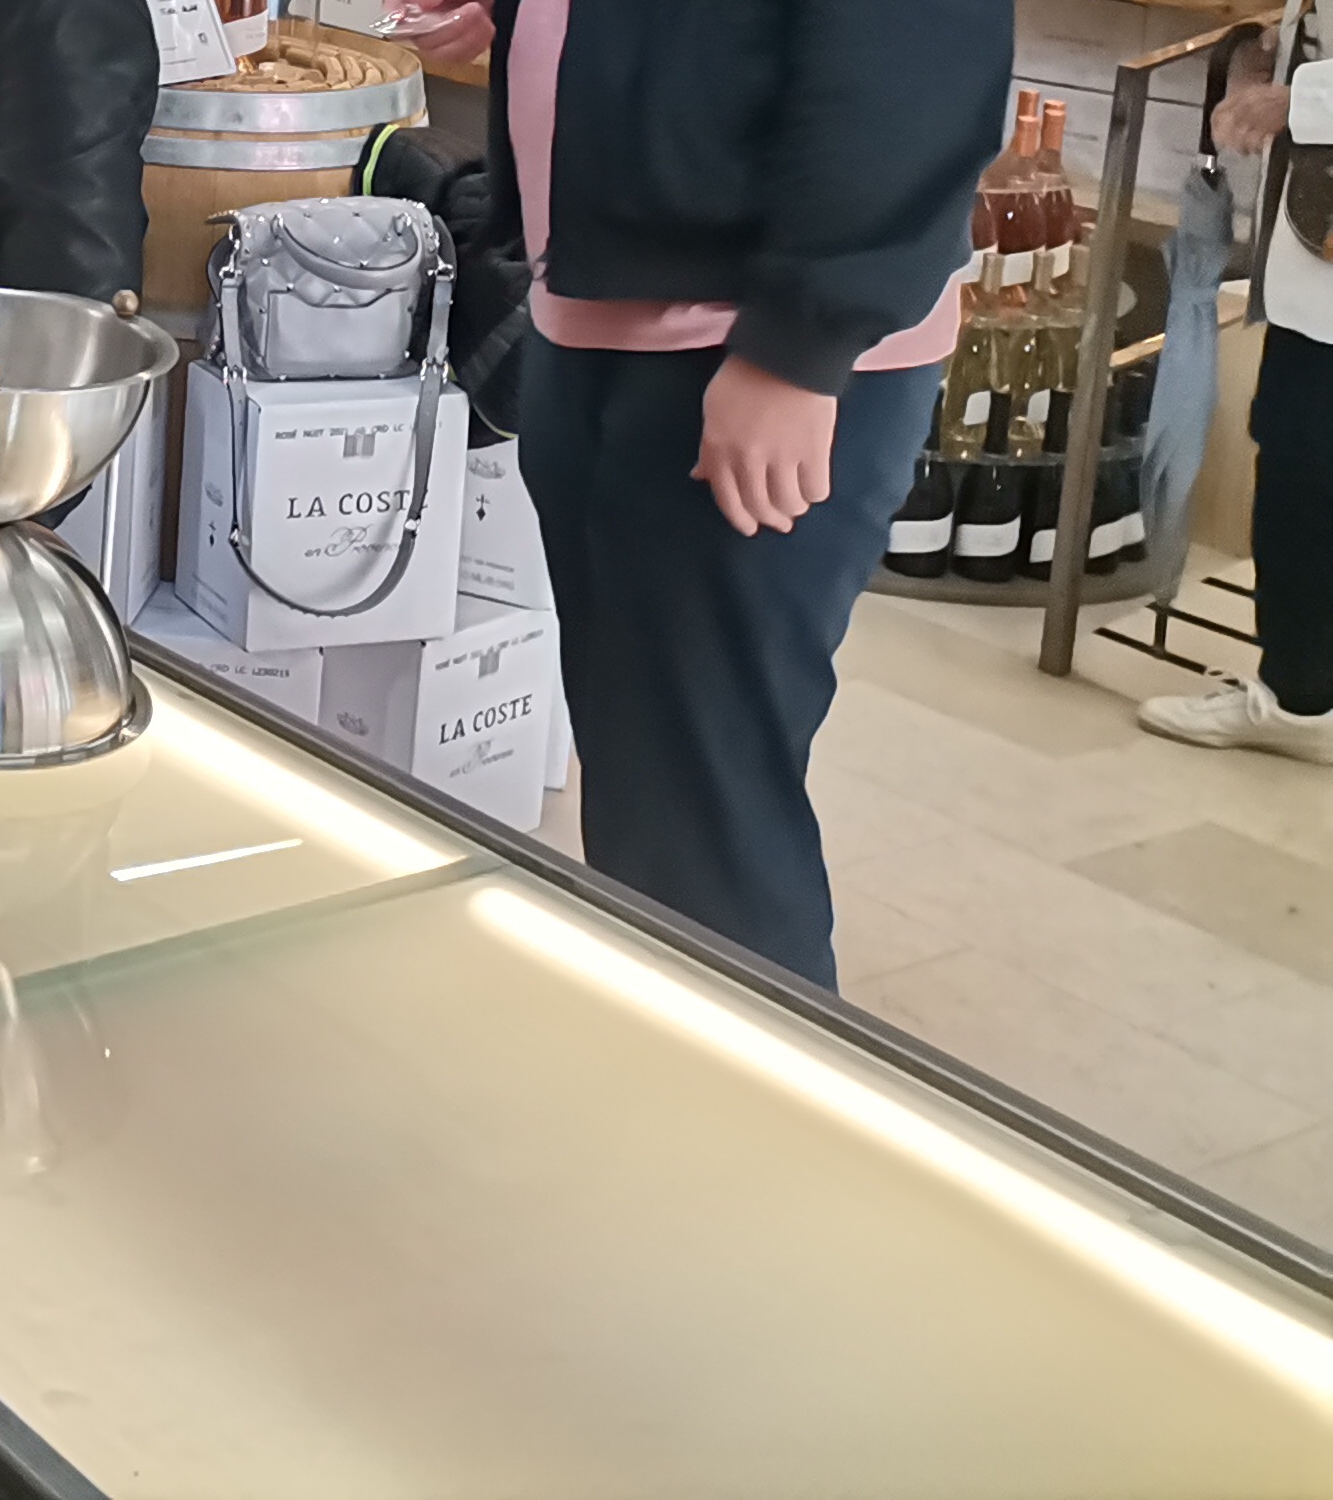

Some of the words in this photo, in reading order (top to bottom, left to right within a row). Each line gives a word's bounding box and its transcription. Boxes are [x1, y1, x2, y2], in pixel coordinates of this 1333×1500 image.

[286, 496, 327, 519] LA
[338, 489, 428, 516] COST
[438, 718, 466, 746] LA
[473, 693, 533, 733] COSTE
